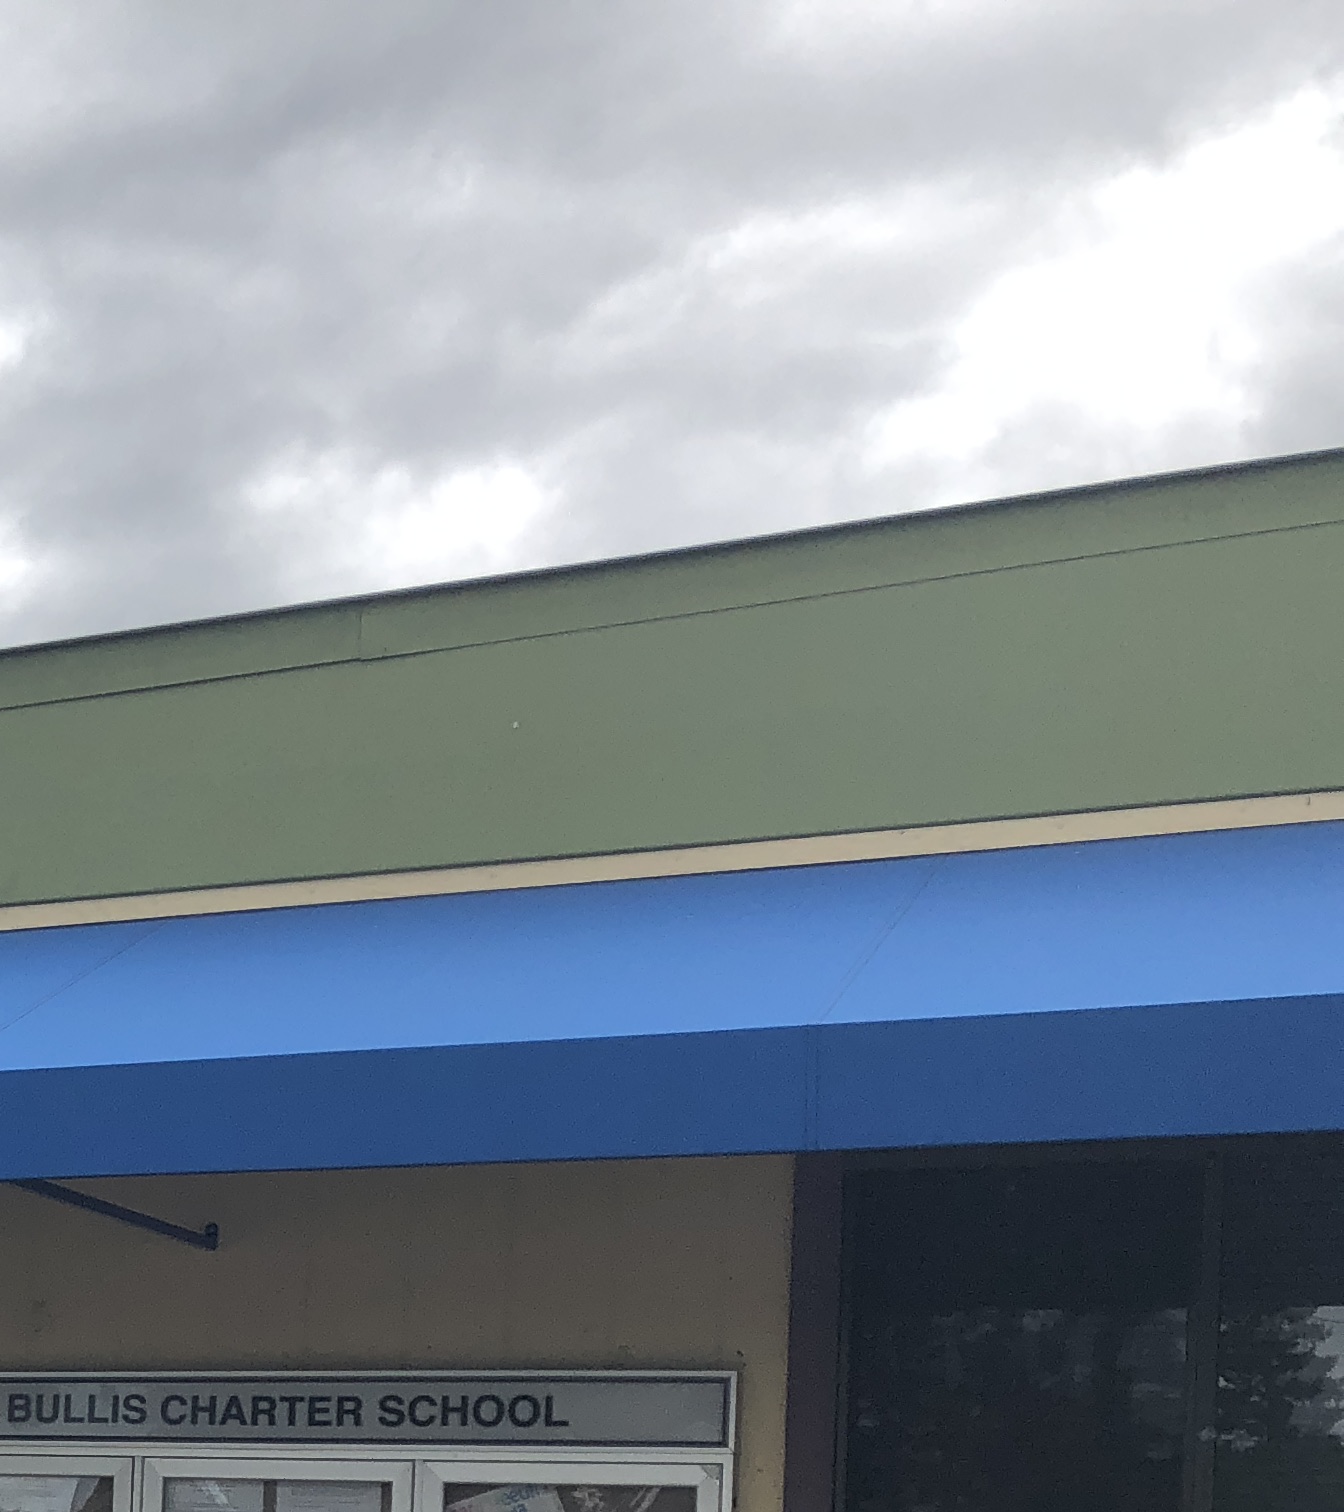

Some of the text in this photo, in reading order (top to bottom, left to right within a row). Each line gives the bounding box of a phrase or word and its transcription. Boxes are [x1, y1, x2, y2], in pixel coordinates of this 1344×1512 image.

[7, 1393, 570, 1430] BULLIS CHARTER SCHOOL
